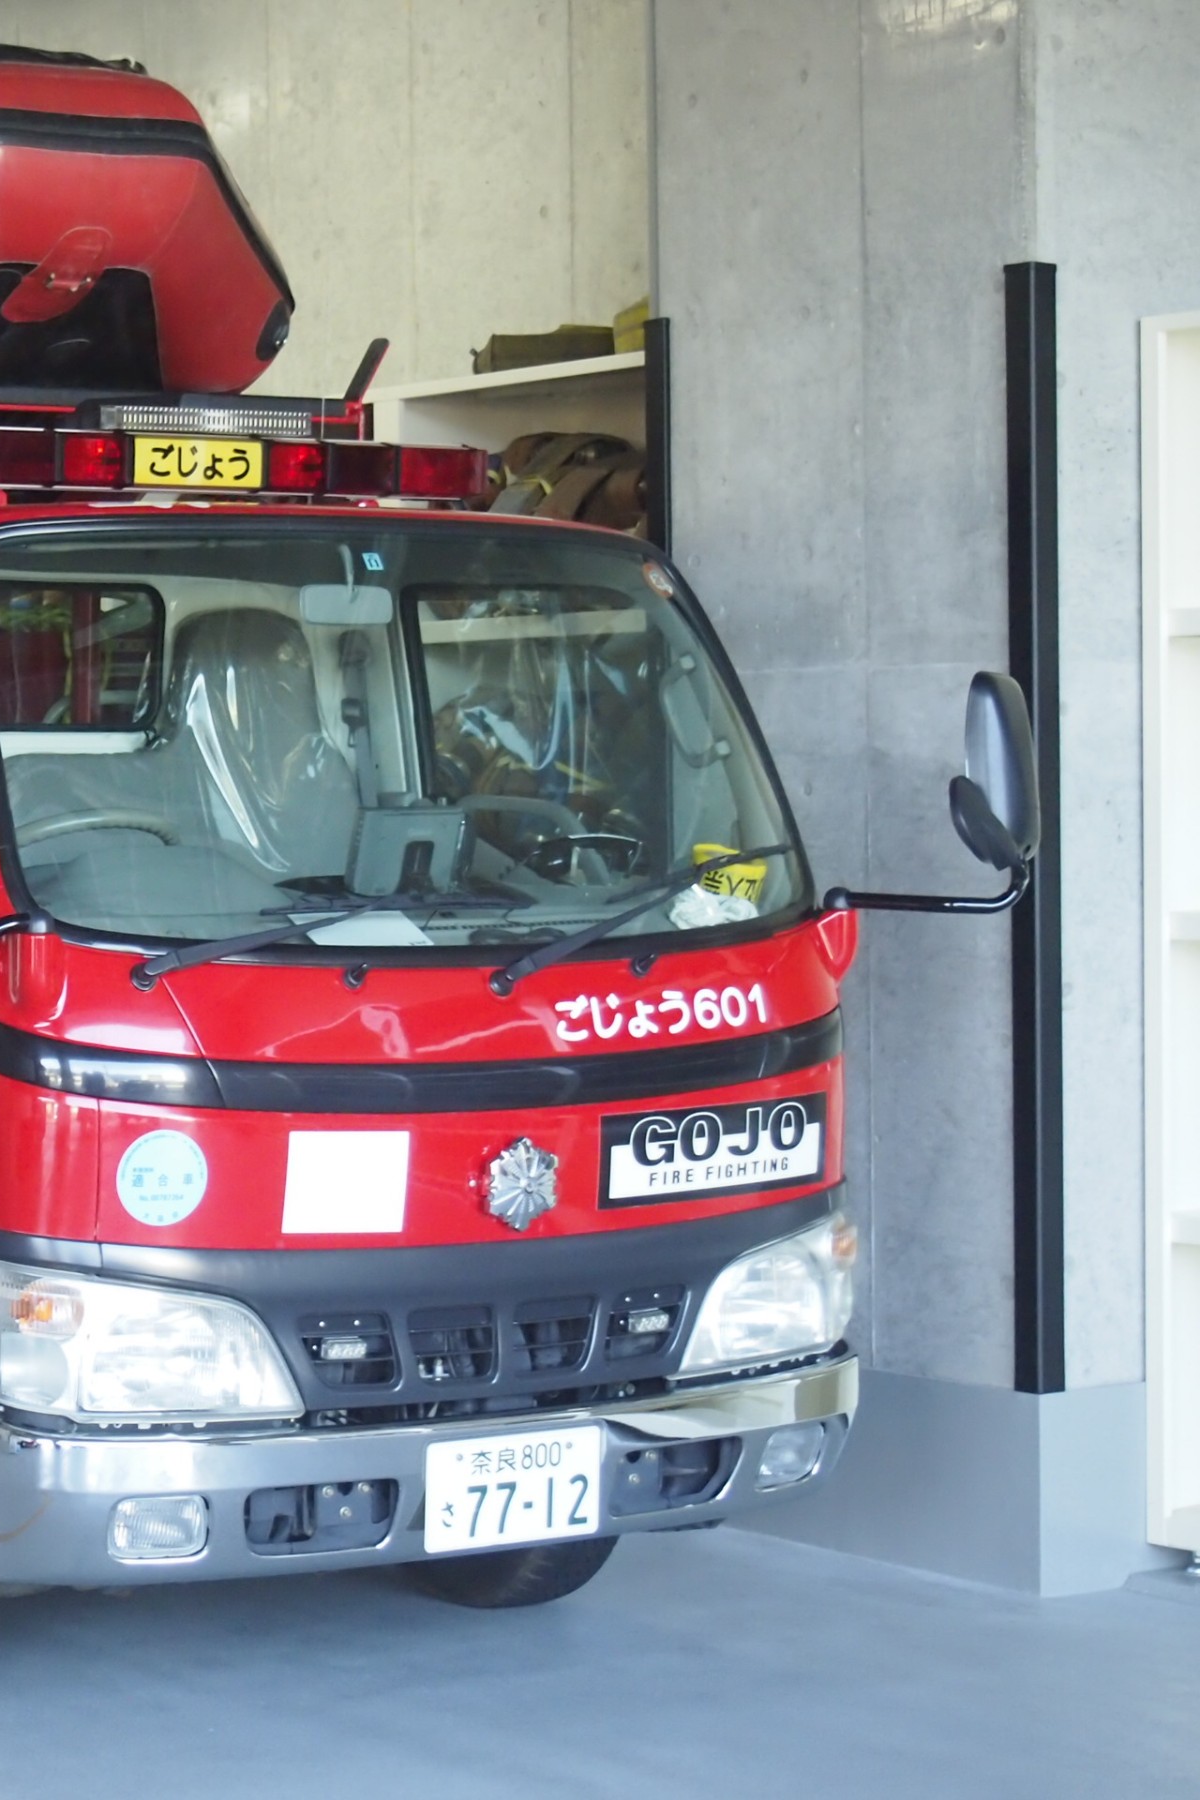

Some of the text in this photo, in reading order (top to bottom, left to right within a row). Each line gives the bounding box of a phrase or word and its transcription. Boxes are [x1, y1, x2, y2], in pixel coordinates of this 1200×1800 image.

[149, 444, 251, 481] ごじょう
[554, 983, 767, 1042] ごじょう601
[629, 1101, 808, 1167] GOJO
[649, 1157, 789, 1187] FIRE FIGHTING
[441, 1474, 589, 1537] さ 77-12
